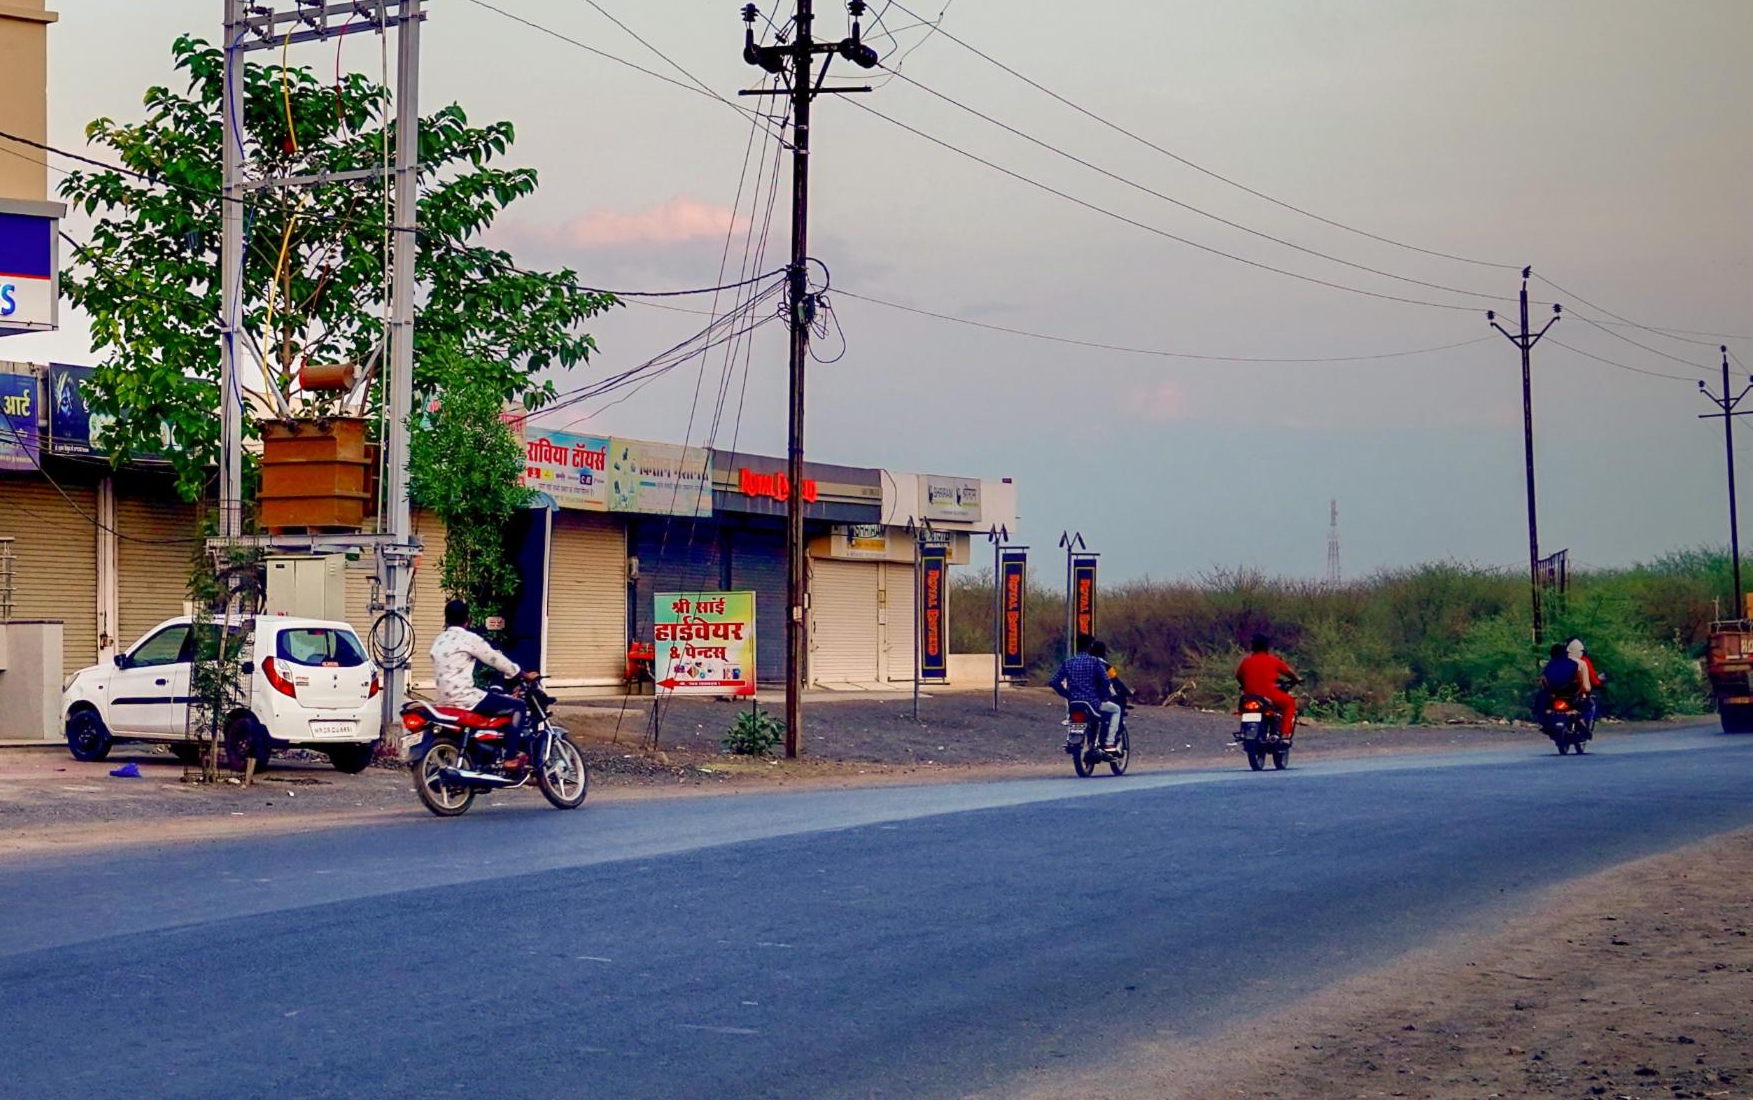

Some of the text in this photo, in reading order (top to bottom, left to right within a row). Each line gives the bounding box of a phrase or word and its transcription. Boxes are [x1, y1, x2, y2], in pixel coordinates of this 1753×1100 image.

[4, 389, 31, 417] आर्ट
[571, 442, 607, 471] टॉयर्स
[672, 598, 691, 614] श्री
[670, 645, 681, 659] &
